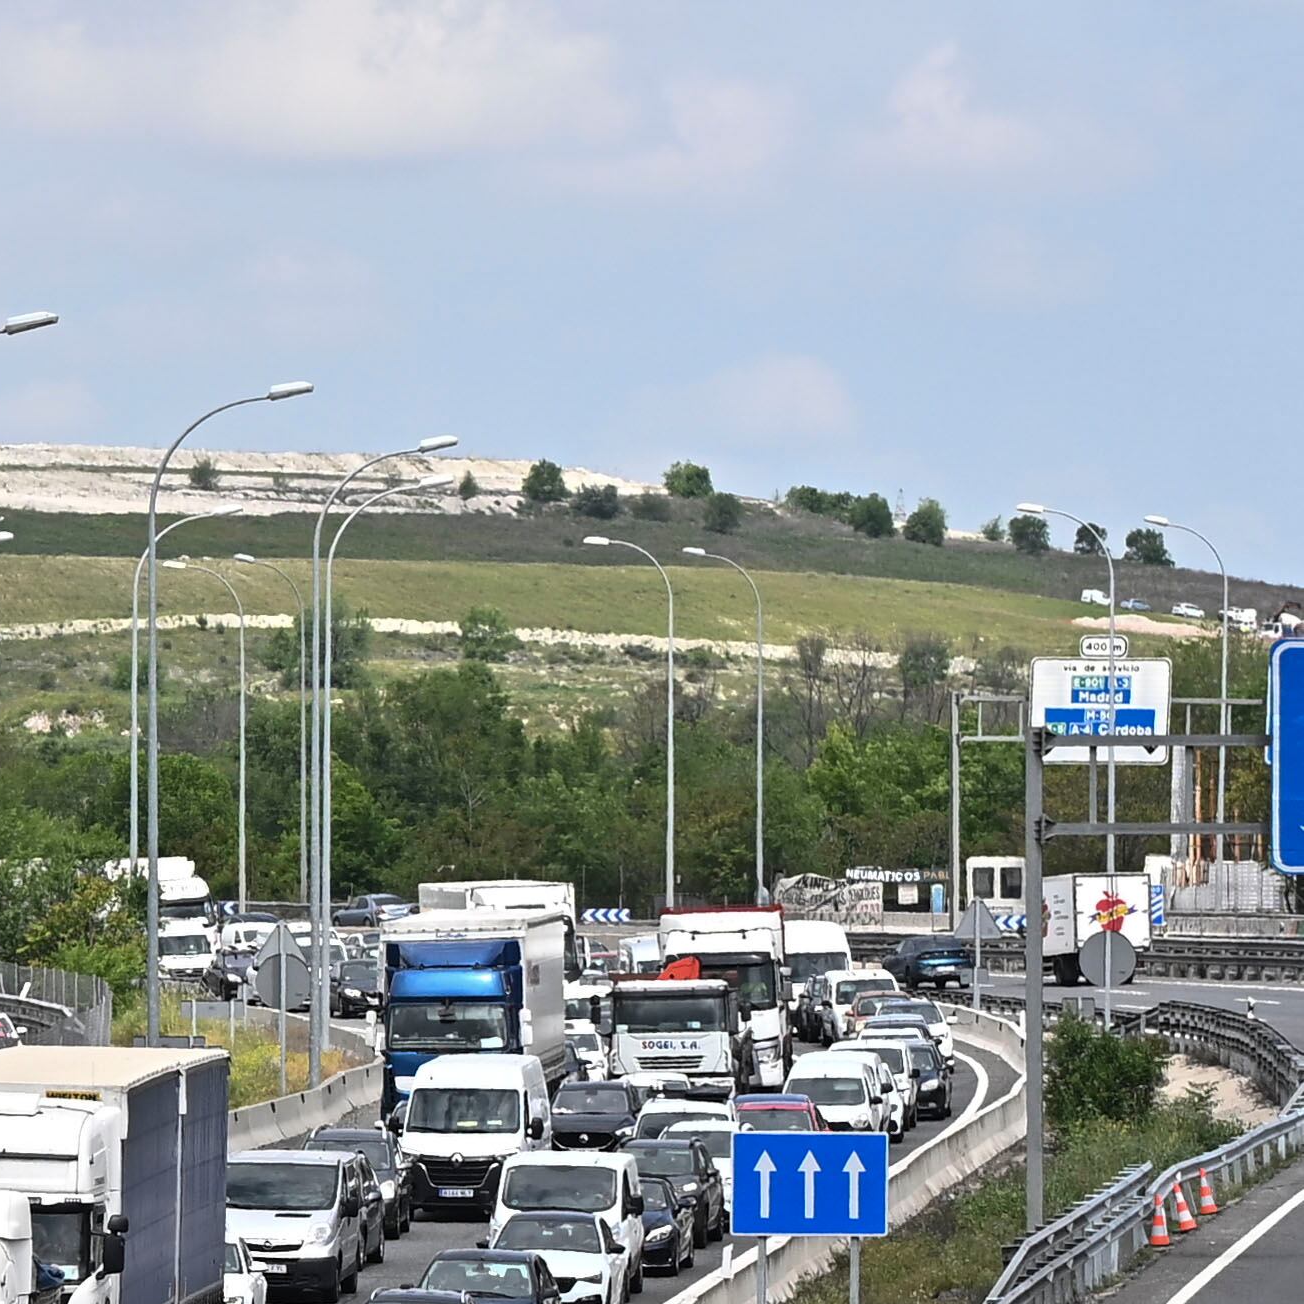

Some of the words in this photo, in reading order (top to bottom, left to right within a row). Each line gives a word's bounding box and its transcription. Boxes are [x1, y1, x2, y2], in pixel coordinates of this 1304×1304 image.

[1085, 642, 1107, 651] 400
[1112, 644, 1122, 652] m
[1084, 664, 1095, 672] de
[1102, 664, 1140, 672] svicio
[1079, 691, 1124, 703] Madrd
[1098, 723, 1152, 735] Crdoba
